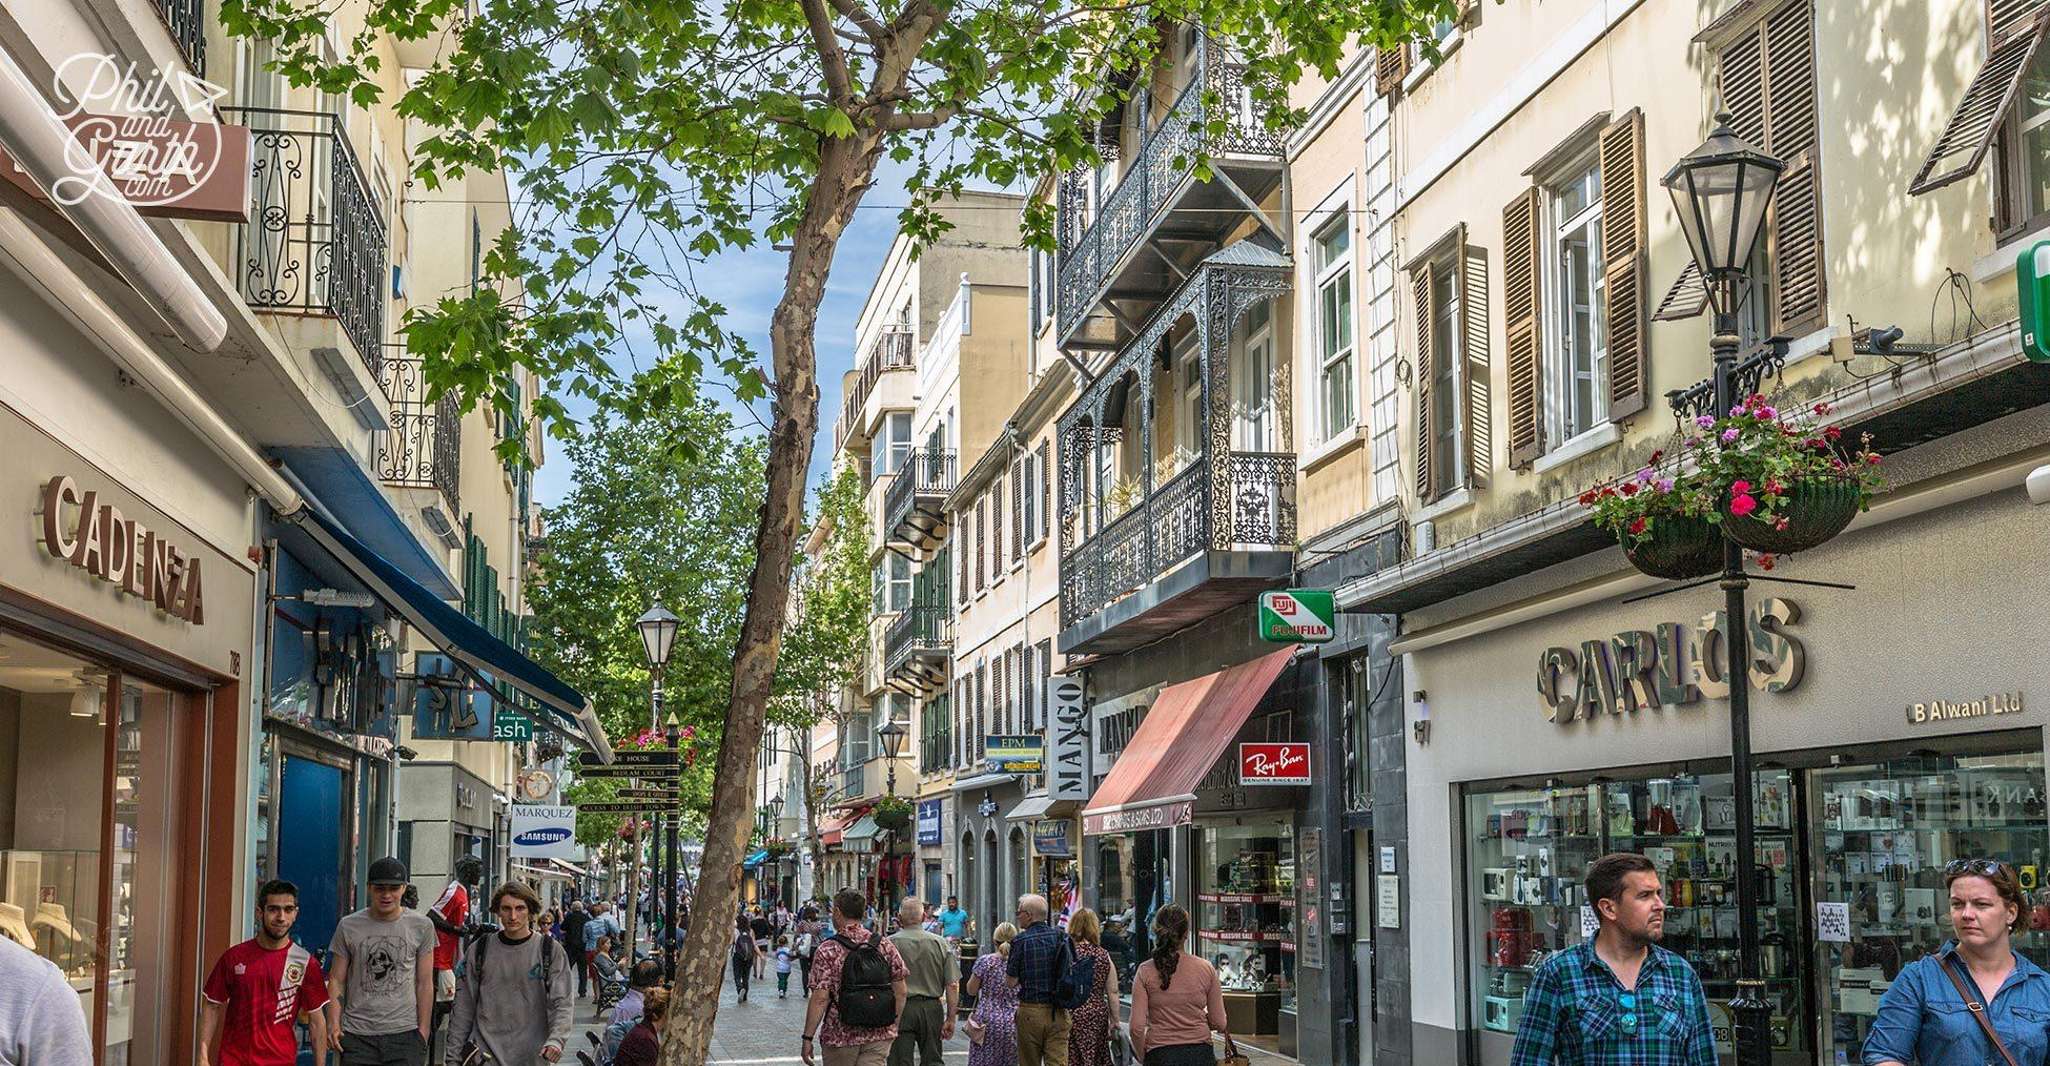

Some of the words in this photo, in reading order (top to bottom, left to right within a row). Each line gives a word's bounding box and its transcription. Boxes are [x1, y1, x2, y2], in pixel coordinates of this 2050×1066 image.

[44, 475, 204, 625] CADENZA
[1272, 624, 1327, 636] FUJIFILM
[1536, 597, 1805, 724] CARLOS
[1930, 699, 1986, 721] Alwani
[1992, 691, 2023, 714] Ltd
[494, 720, 527, 738] ash
[1056, 683, 1082, 793] MANGO
[1001, 738, 1026, 748] EPM
[515, 808, 573, 819] MARQUEZ
[520, 832, 566, 841] SAMSUNG
